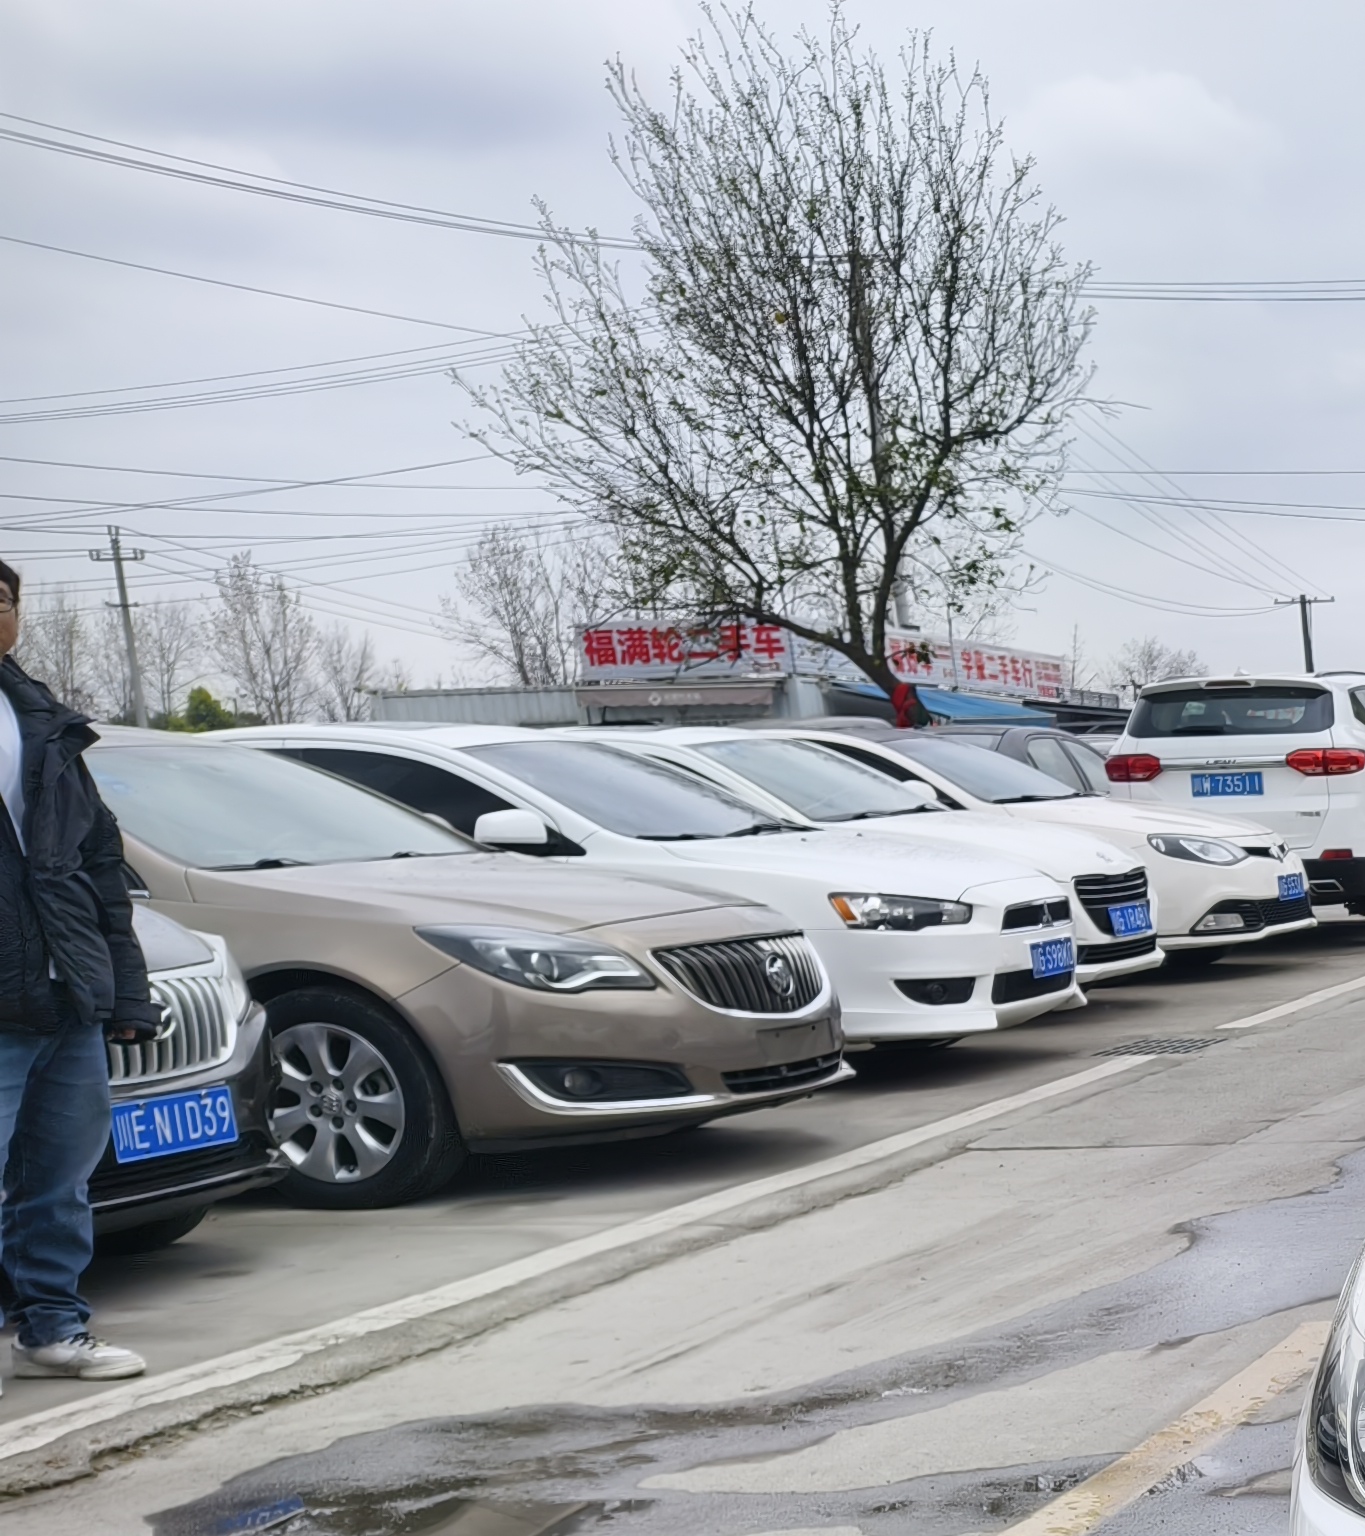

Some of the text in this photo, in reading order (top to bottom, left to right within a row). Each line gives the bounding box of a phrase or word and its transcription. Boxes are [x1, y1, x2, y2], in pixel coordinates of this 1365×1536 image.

[583, 624, 785, 667] 福满轮二手车
